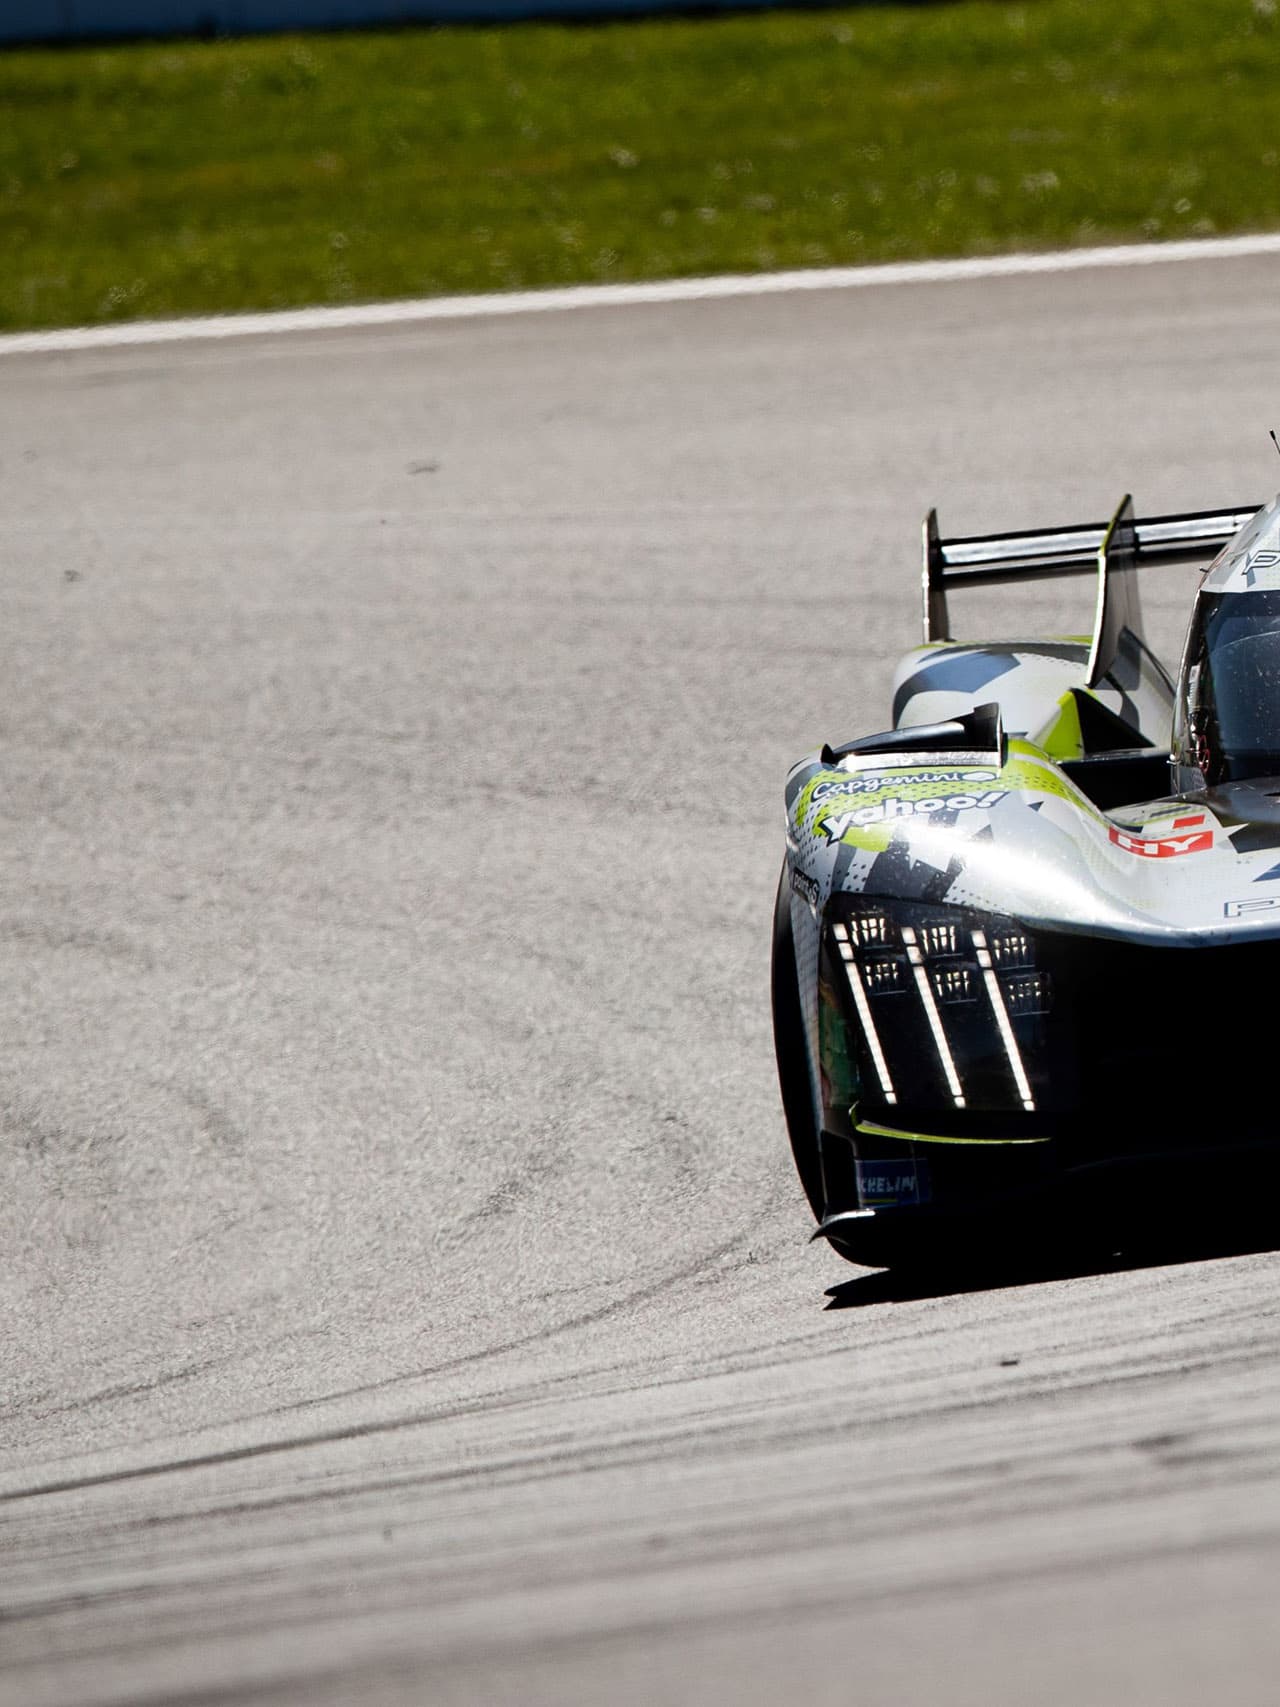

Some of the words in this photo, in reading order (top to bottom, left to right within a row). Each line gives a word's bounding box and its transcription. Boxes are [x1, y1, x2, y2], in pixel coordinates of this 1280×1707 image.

[812, 771, 959, 799] Capgemini
[820, 791, 1007, 844] yahoo!
[1118, 834, 1204, 855] HY
